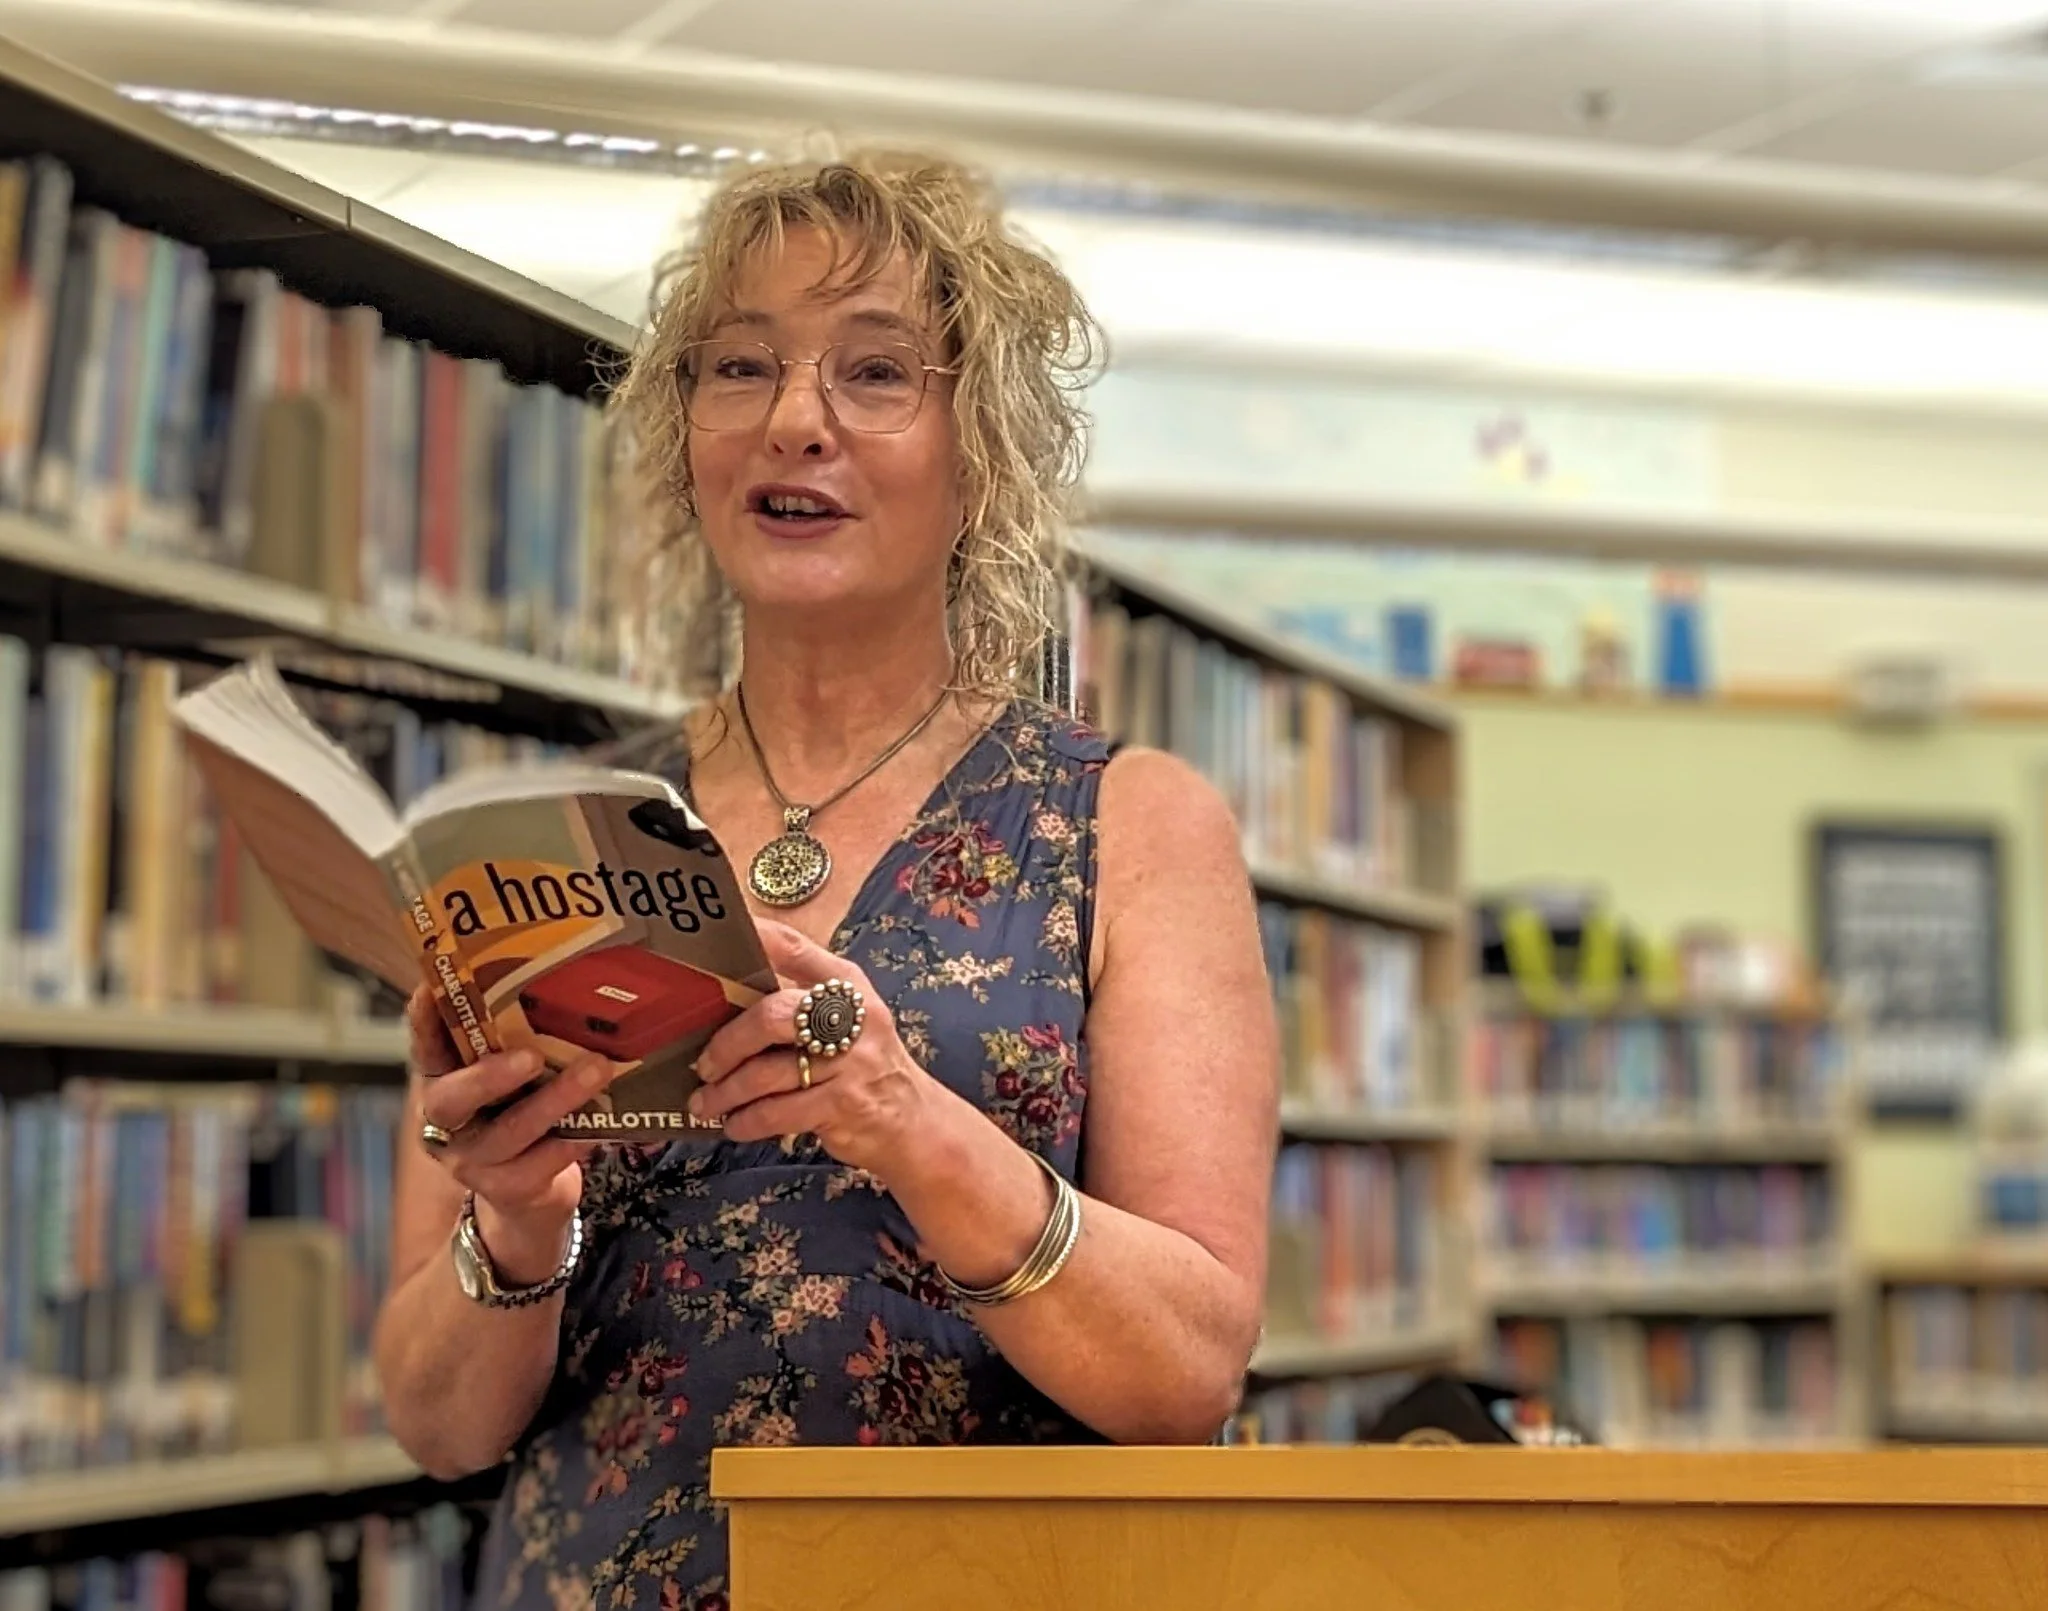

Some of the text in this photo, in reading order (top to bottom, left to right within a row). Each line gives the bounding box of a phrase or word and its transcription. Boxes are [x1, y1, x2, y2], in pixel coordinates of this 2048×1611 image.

[444, 861, 726, 936] a hostage
[435, 955, 478, 1030] CHARLOTTE
[552, 1112, 727, 1129] HARLOTTE ME
